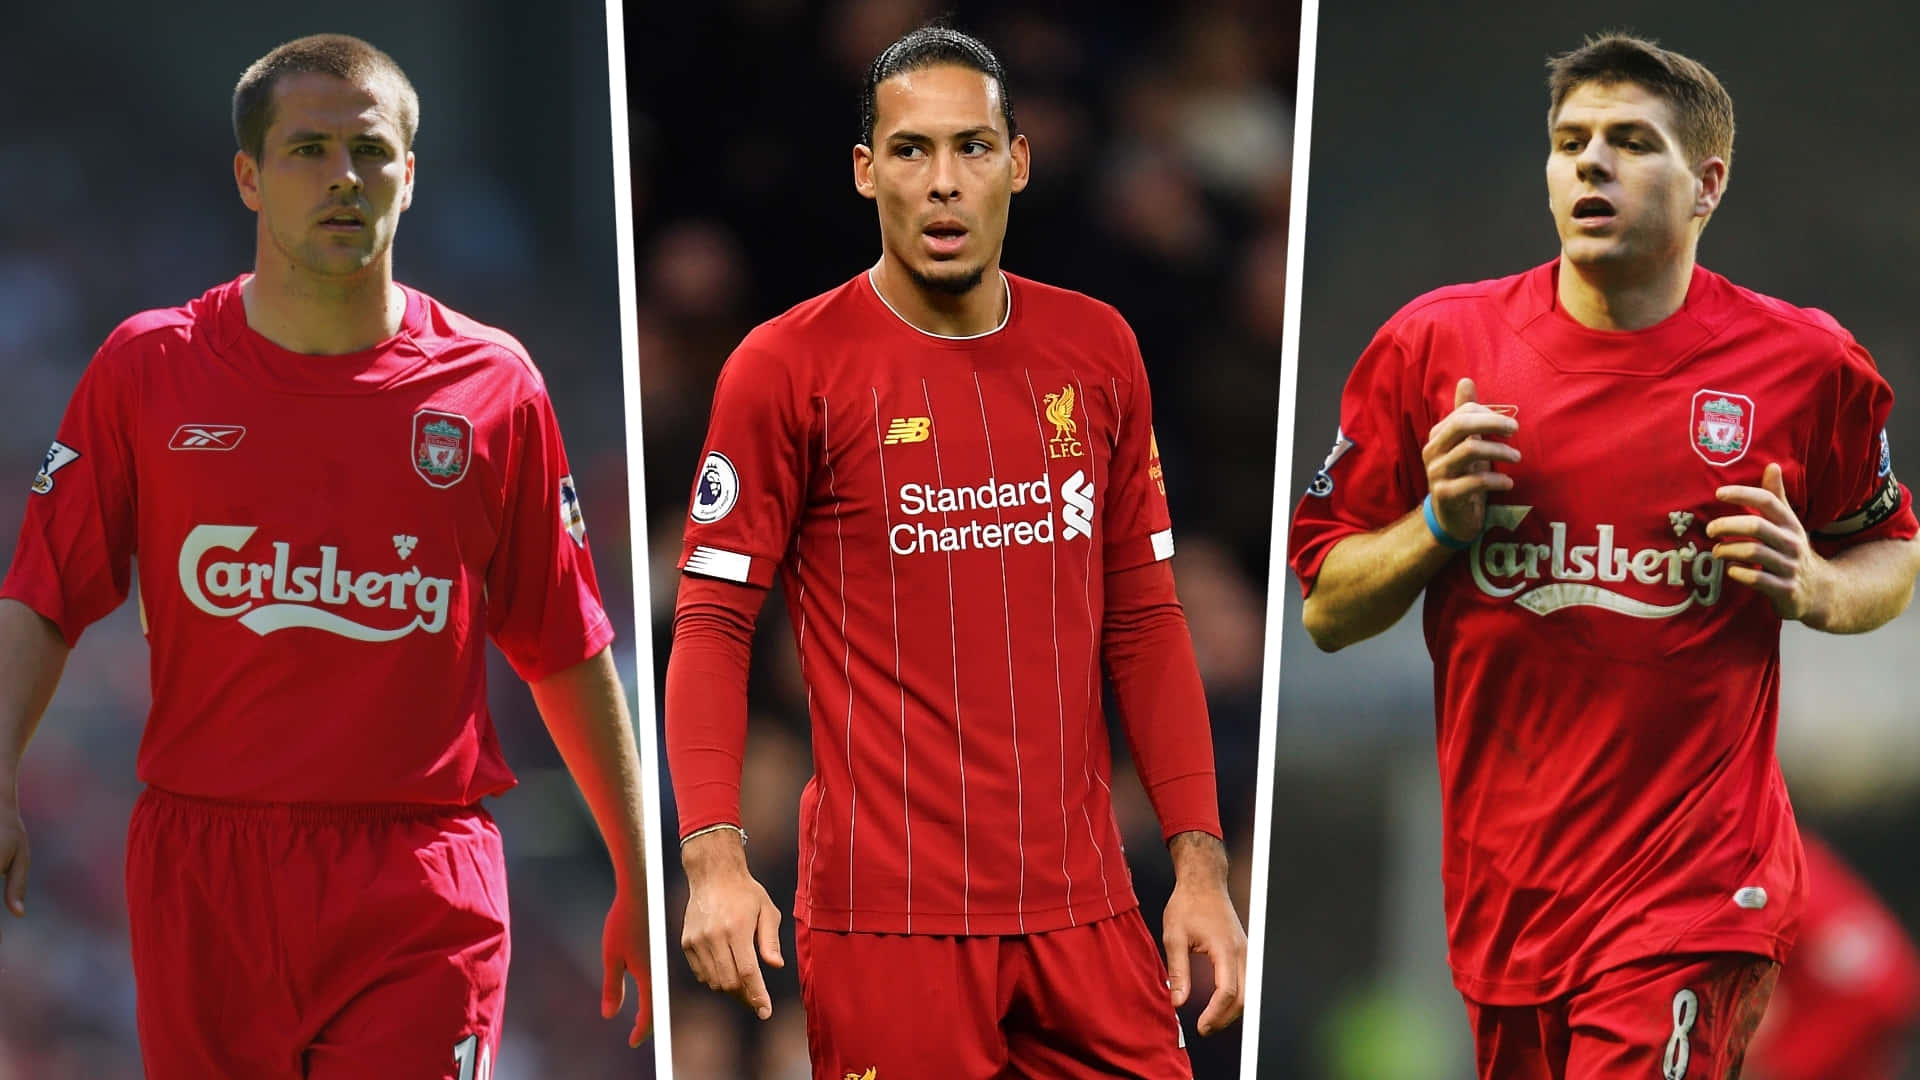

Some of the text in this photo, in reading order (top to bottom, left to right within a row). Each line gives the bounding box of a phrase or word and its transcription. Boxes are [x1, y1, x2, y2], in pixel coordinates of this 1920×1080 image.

[889, 512, 1054, 555] Chartered
[900, 473, 1051, 515] Standard
[179, 524, 453, 634] Carlsberg
[1470, 505, 1724, 607] Carlsberg
[1662, 988, 1698, 1080] 8
